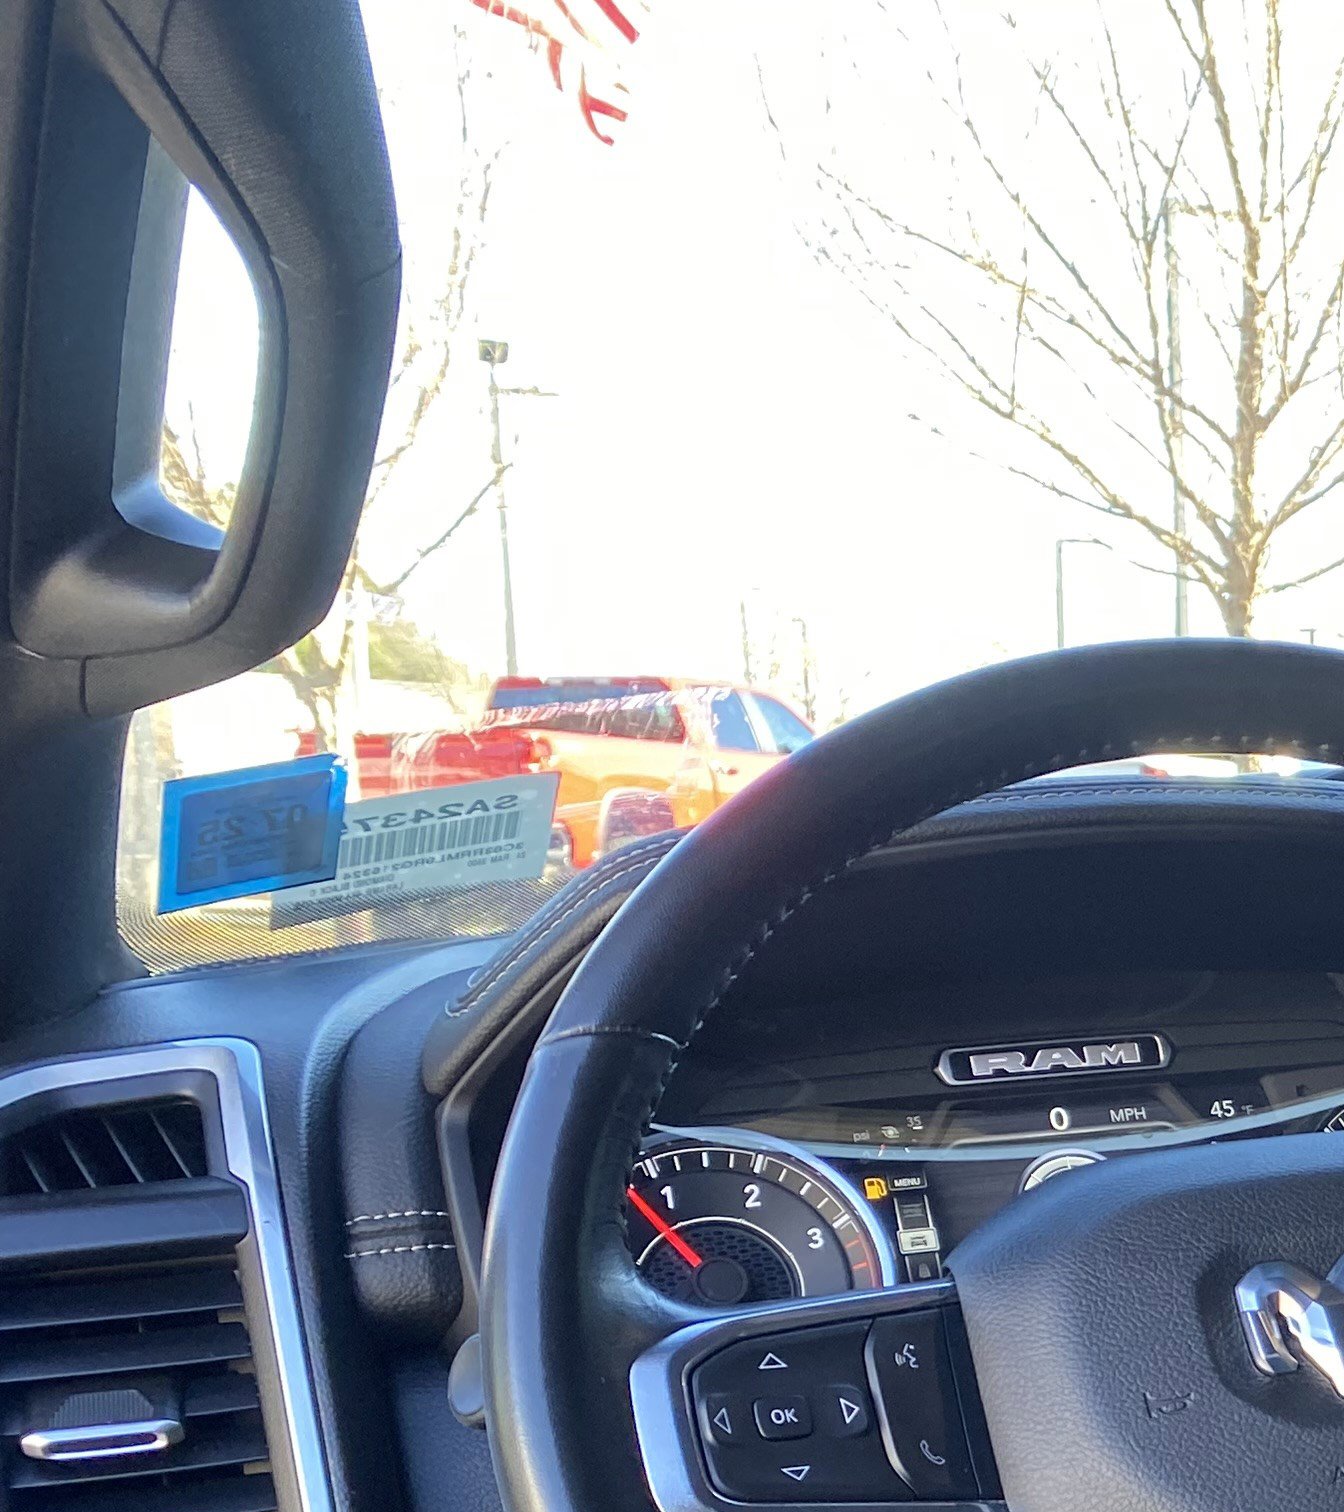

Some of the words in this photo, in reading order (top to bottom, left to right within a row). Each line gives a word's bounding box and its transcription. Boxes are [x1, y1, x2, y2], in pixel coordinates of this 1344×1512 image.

[968, 1041, 1142, 1078] RAM
[1048, 1106, 1069, 1131] 0
[1108, 1106, 1148, 1123] MPH
[1209, 1099, 1236, 1119] 45
[906, 1115, 922, 1128] 35
[852, 1129, 871, 1143] psi
[893, 1177, 921, 1188] MENU
[659, 1185, 675, 1210] 1
[743, 1184, 762, 1208] 2
[806, 1227, 825, 1250] 3
[769, 1407, 798, 1425] OK
